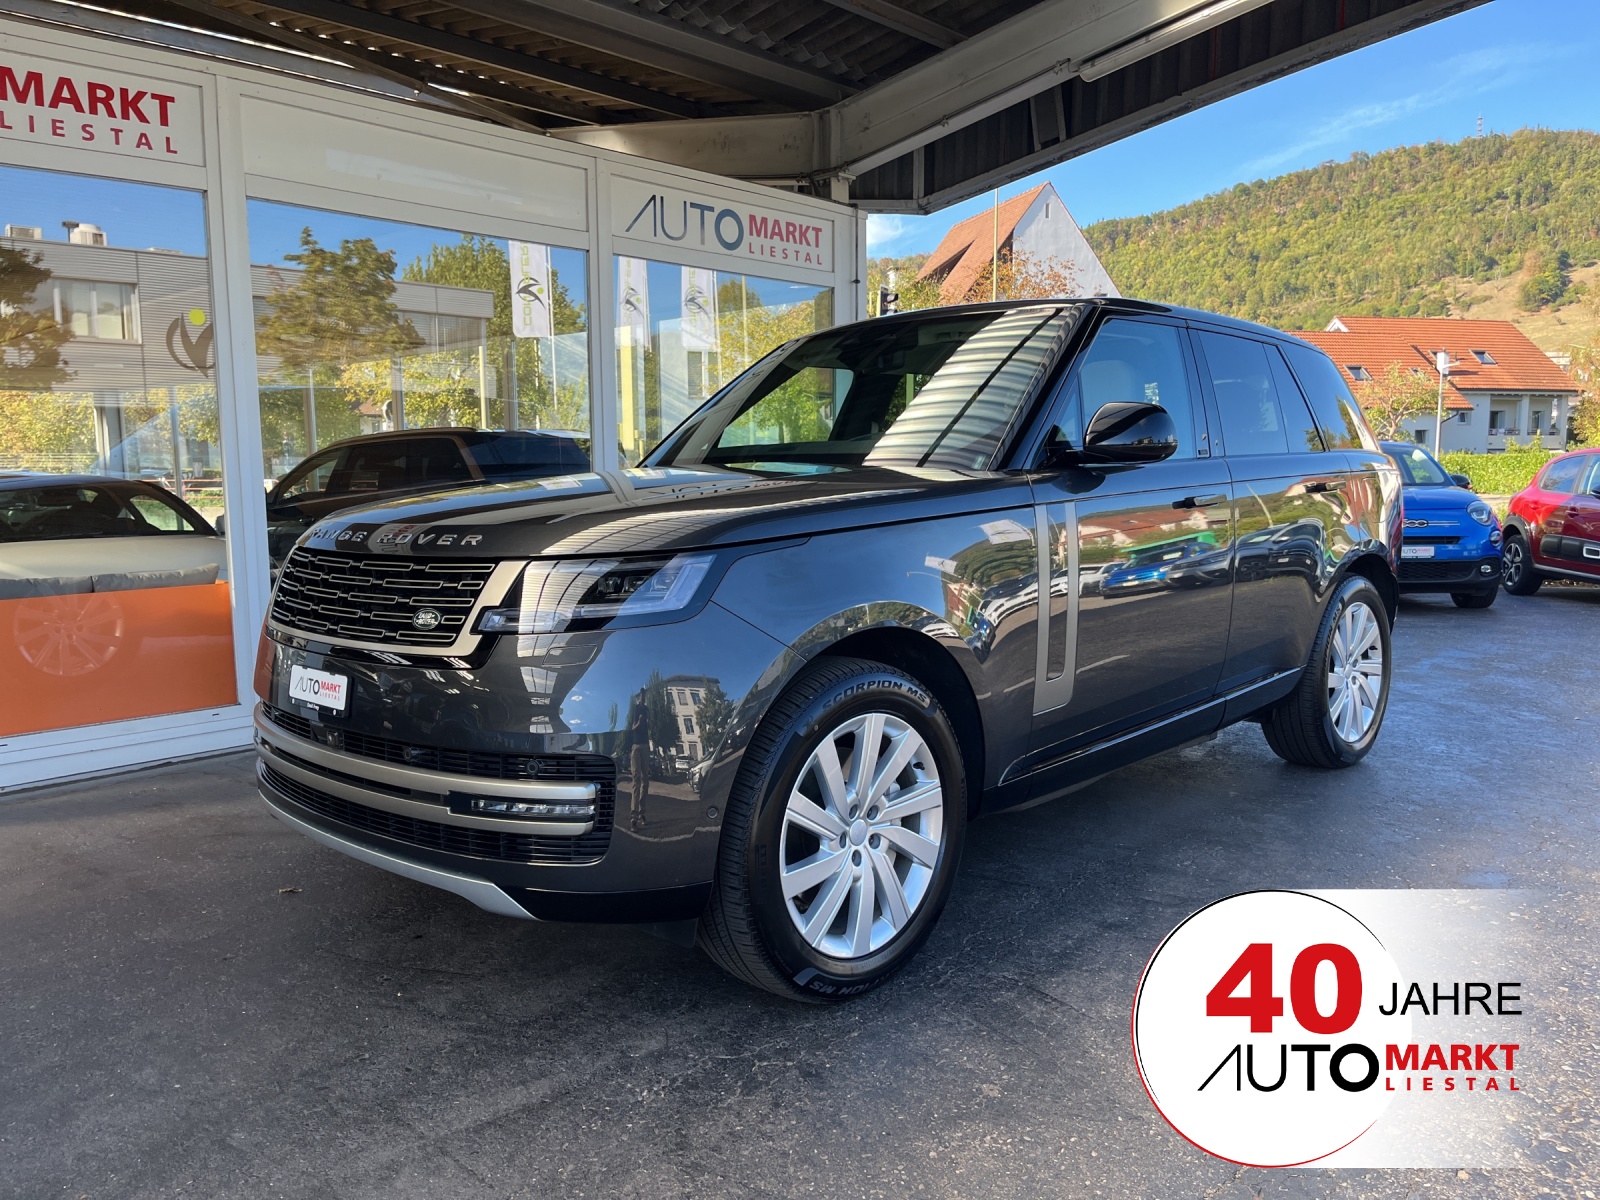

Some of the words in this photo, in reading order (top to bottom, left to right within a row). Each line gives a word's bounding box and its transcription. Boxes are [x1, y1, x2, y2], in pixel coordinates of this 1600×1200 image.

[0, 66, 175, 127] MARKT
[0, 111, 178, 154] LIESTAL
[625, 194, 744, 251] AUTO
[749, 214, 823, 249] MARKT
[749, 242, 823, 265] LIESTAL
[309, 528, 368, 542] RANGE
[377, 532, 483, 546] ROVER
[295, 676, 320, 695] AUTO
[320, 681, 341, 694] MARKT
[822, 680, 903, 710] SCORPION
[906, 686, 927, 703] MS
